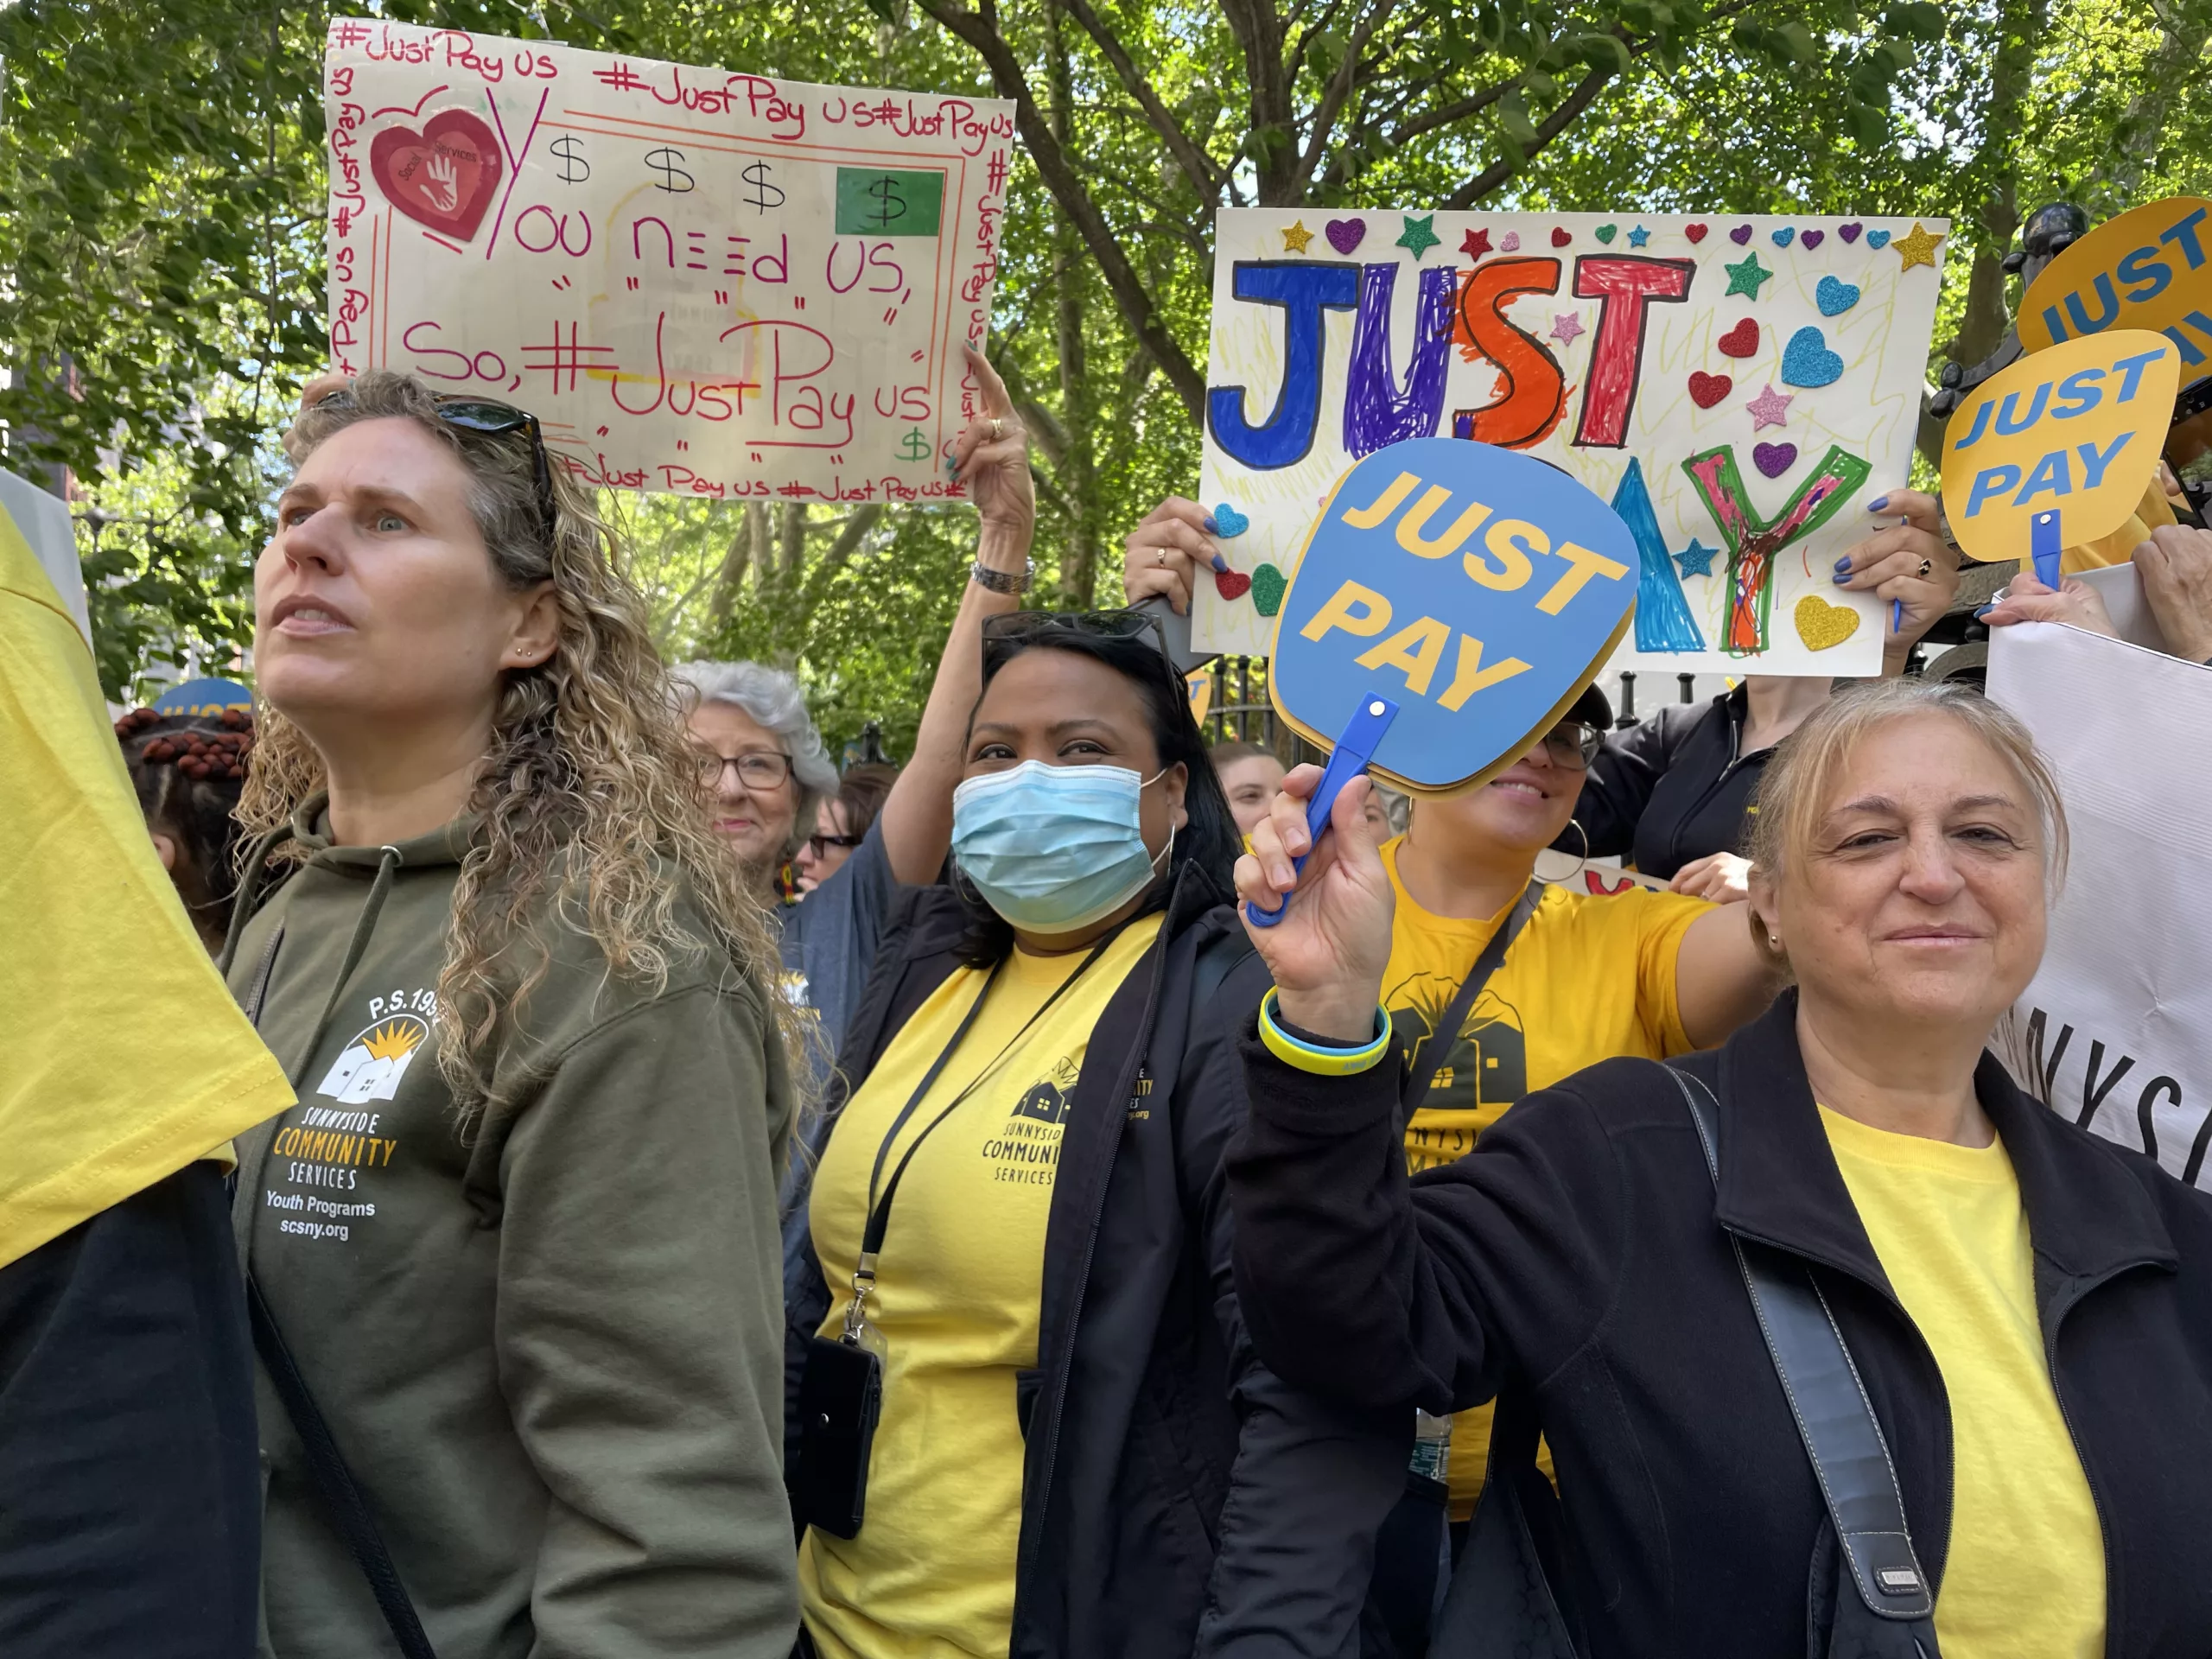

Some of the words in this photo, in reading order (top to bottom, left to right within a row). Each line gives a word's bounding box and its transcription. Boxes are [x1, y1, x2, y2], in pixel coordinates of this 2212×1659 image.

[433, 29, 504, 83] Pay
[727, 74, 805, 141] Pay
[938, 99, 988, 157] Pay
[331, 102, 365, 156] Pay
[397, 151, 423, 181] Social
[435, 140, 478, 163] Services
[961, 253, 997, 302] Pay
[2042, 207, 2209, 346] JUST
[332, 288, 370, 359] Pay
[403, 321, 522, 392] So,
[719, 320, 855, 448] Pay
[1206, 254, 1697, 471] JUST
[1954, 346, 2167, 450] JUST
[657, 464, 725, 498] Pay
[880, 476, 918, 501] Pay
[1964, 430, 2138, 518] PAY
[1340, 469, 1630, 618] JUST
[1611, 443, 1873, 658] AY
[1300, 579, 1534, 714] PAY
[301, 1105, 380, 1135] SUNNYSIDE
[1003, 1122, 1062, 1141] SUNNYSID
[273, 1126, 398, 1168] COMMUNITY
[982, 1139, 1059, 1165] COMMUNI
[288, 1160, 358, 1191] SERVICES
[994, 1166, 1053, 1185] SERVICES
[265, 1190, 304, 1211] Youth
[307, 1196, 377, 1218] Programs
[279, 1218, 350, 1243] scsny.org
